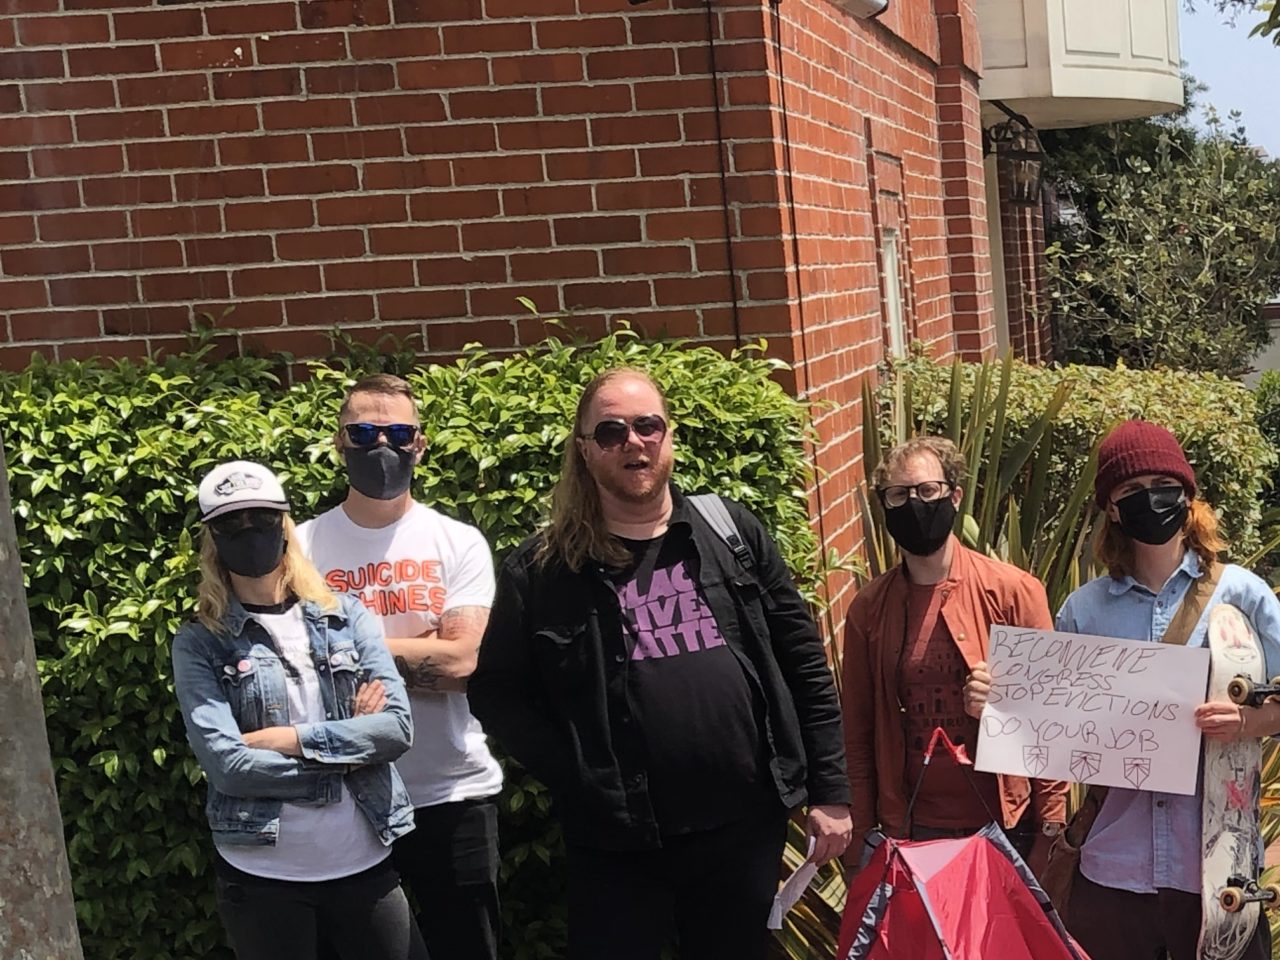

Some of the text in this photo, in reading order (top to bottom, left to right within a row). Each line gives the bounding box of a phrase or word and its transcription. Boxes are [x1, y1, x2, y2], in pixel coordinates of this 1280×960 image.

[325, 559, 442, 593] SUICIDE
[993, 630, 1166, 674] RECONVENE
[991, 660, 1117, 691] CONGRESS
[1043, 686, 1180, 721] EVICTIONS
[984, 715, 1022, 738] DO
[1028, 718, 1100, 746] YOUR
[1104, 727, 1160, 753] JOB
